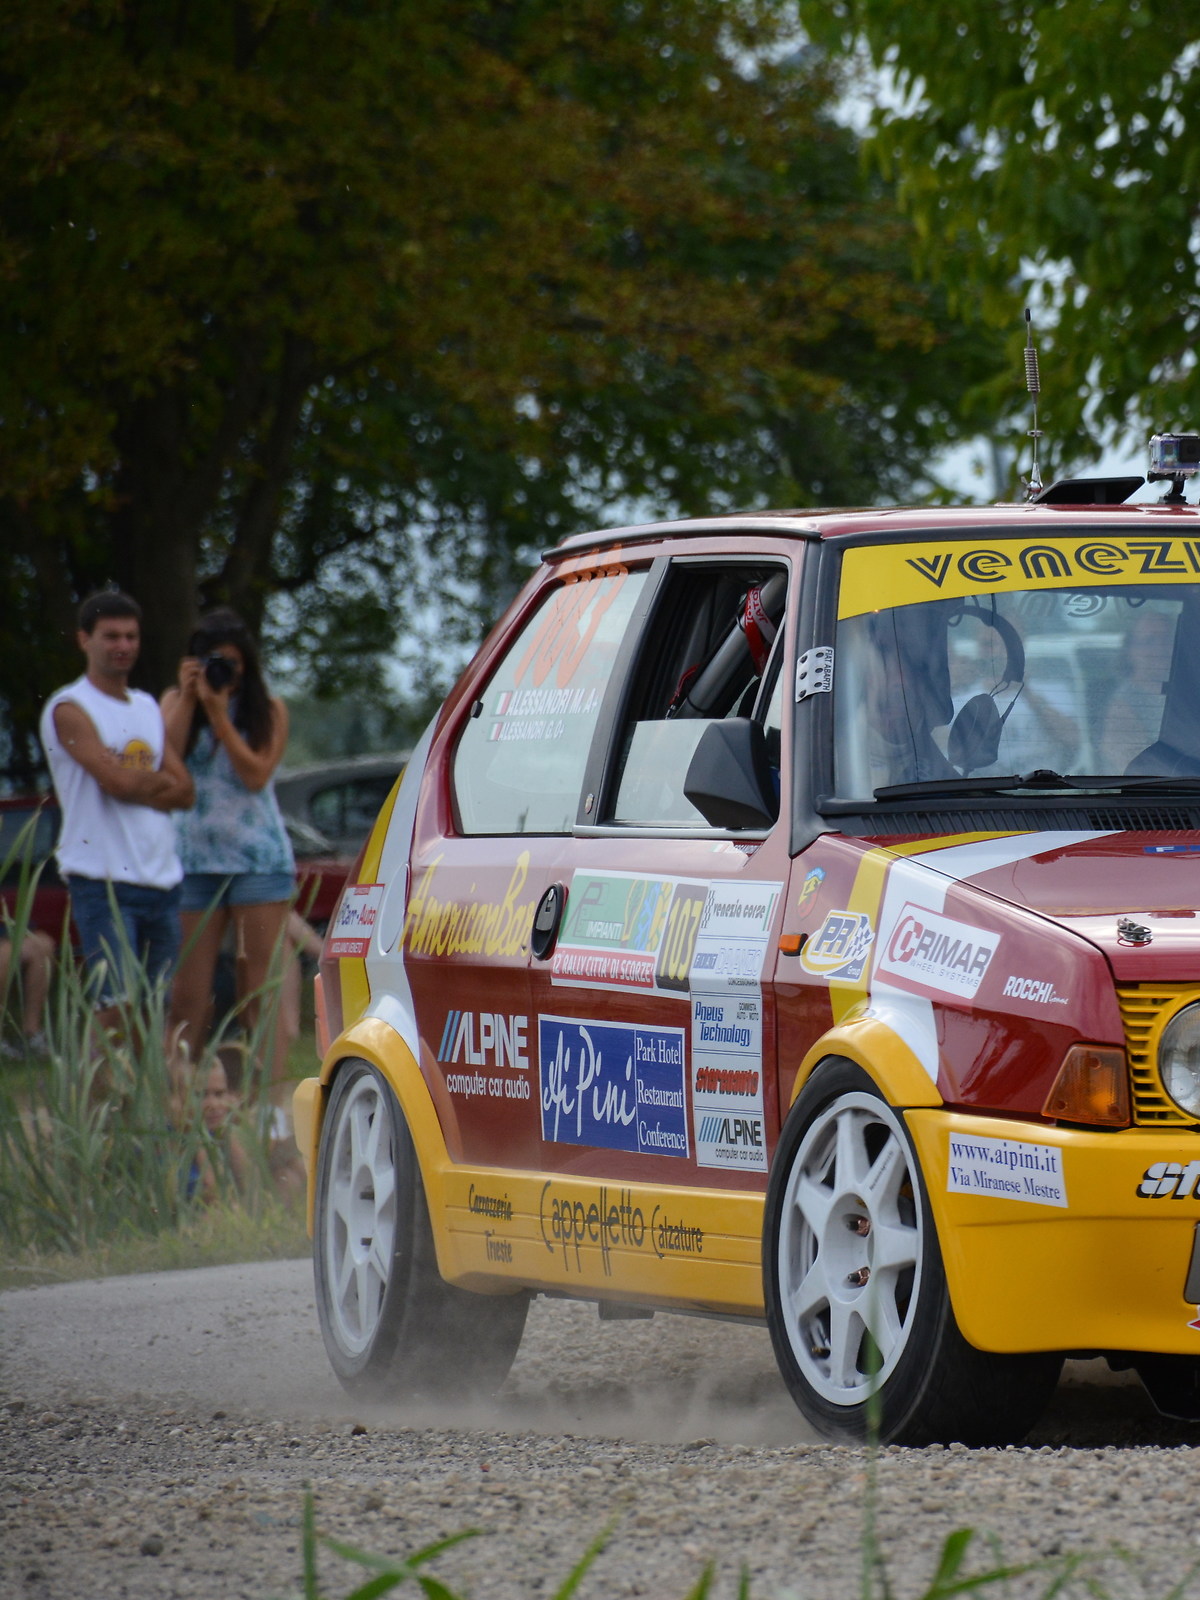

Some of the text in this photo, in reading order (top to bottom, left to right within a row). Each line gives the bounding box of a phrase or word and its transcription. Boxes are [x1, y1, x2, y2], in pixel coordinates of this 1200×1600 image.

[822, 648, 833, 691] FIAT ABARTH
[505, 688, 574, 716] ALESSANDRI
[498, 721, 547, 742] ALESSANDRI
[713, 898, 766, 920] venezia corse
[585, 920, 624, 941] IMPIANTI
[888, 915, 991, 978] CRIMAR
[562, 953, 587, 975] RALLY
[610, 958, 620, 979] DI
[693, 954, 718, 969] FIAT
[909, 959, 980, 988] WHEEL SYSTEMS
[1002, 975, 1054, 1003] ROCCHI
[694, 1001, 724, 1022] Pneus
[451, 1011, 529, 1070] ALPINE
[700, 1021, 752, 1047] Technology
[636, 1037, 682, 1065] Park Hotel
[446, 1073, 530, 1100] computer car audio
[575, 1025, 636, 1138] Pini
[637, 1079, 683, 1109] Restaurant
[639, 1120, 686, 1151] Conference
[718, 1118, 762, 1147] ALPINE
[714, 1148, 764, 1162] computer car audio
[950, 1141, 1057, 1173] www.aipini.it
[950, 1166, 1061, 1200] Via Miranese Mestre
[540, 1179, 703, 1277] Cappelletto Calzature
[484, 1229, 512, 1263] Trieste
